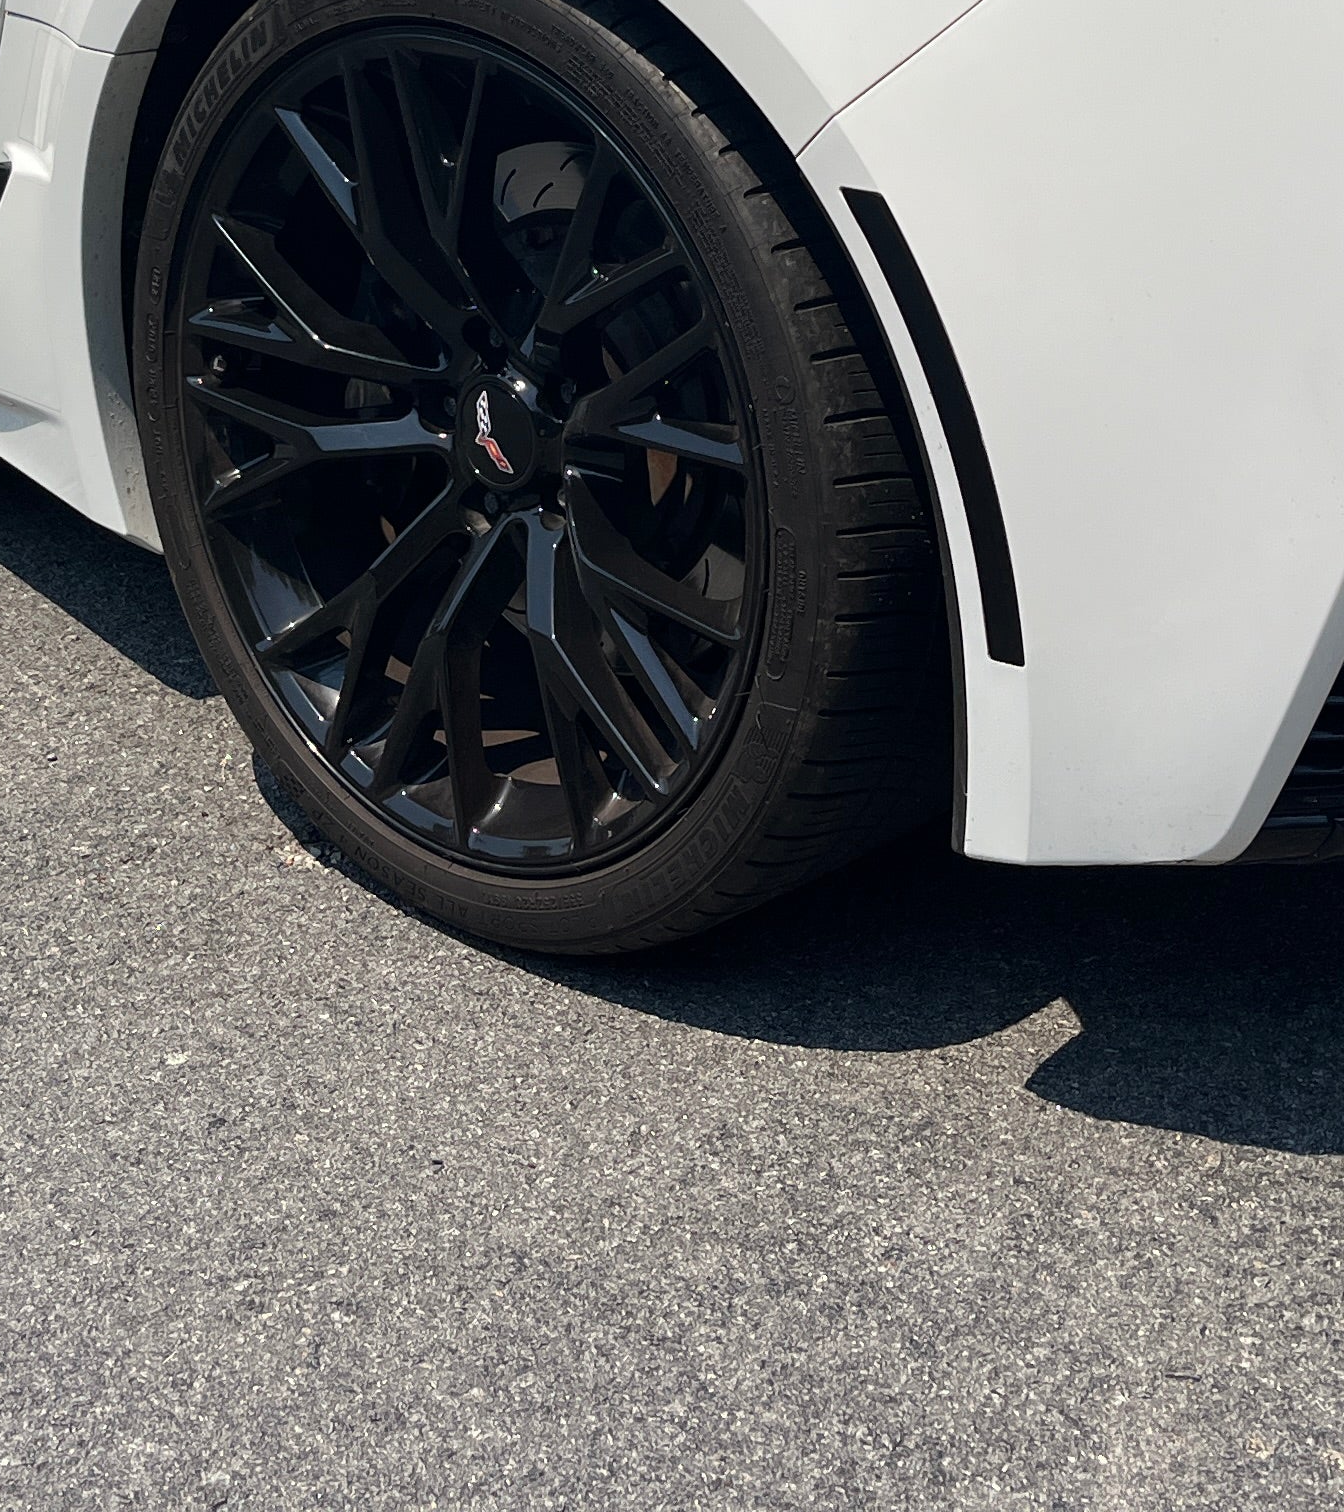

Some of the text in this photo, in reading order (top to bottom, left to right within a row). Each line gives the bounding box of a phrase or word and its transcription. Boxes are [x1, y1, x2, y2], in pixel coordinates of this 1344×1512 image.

[173, 19, 267, 167] MICHELIN
[353, 846, 426, 909] SEASON
[613, 786, 751, 920] MICHELIN
[437, 893, 468, 918] ALL
